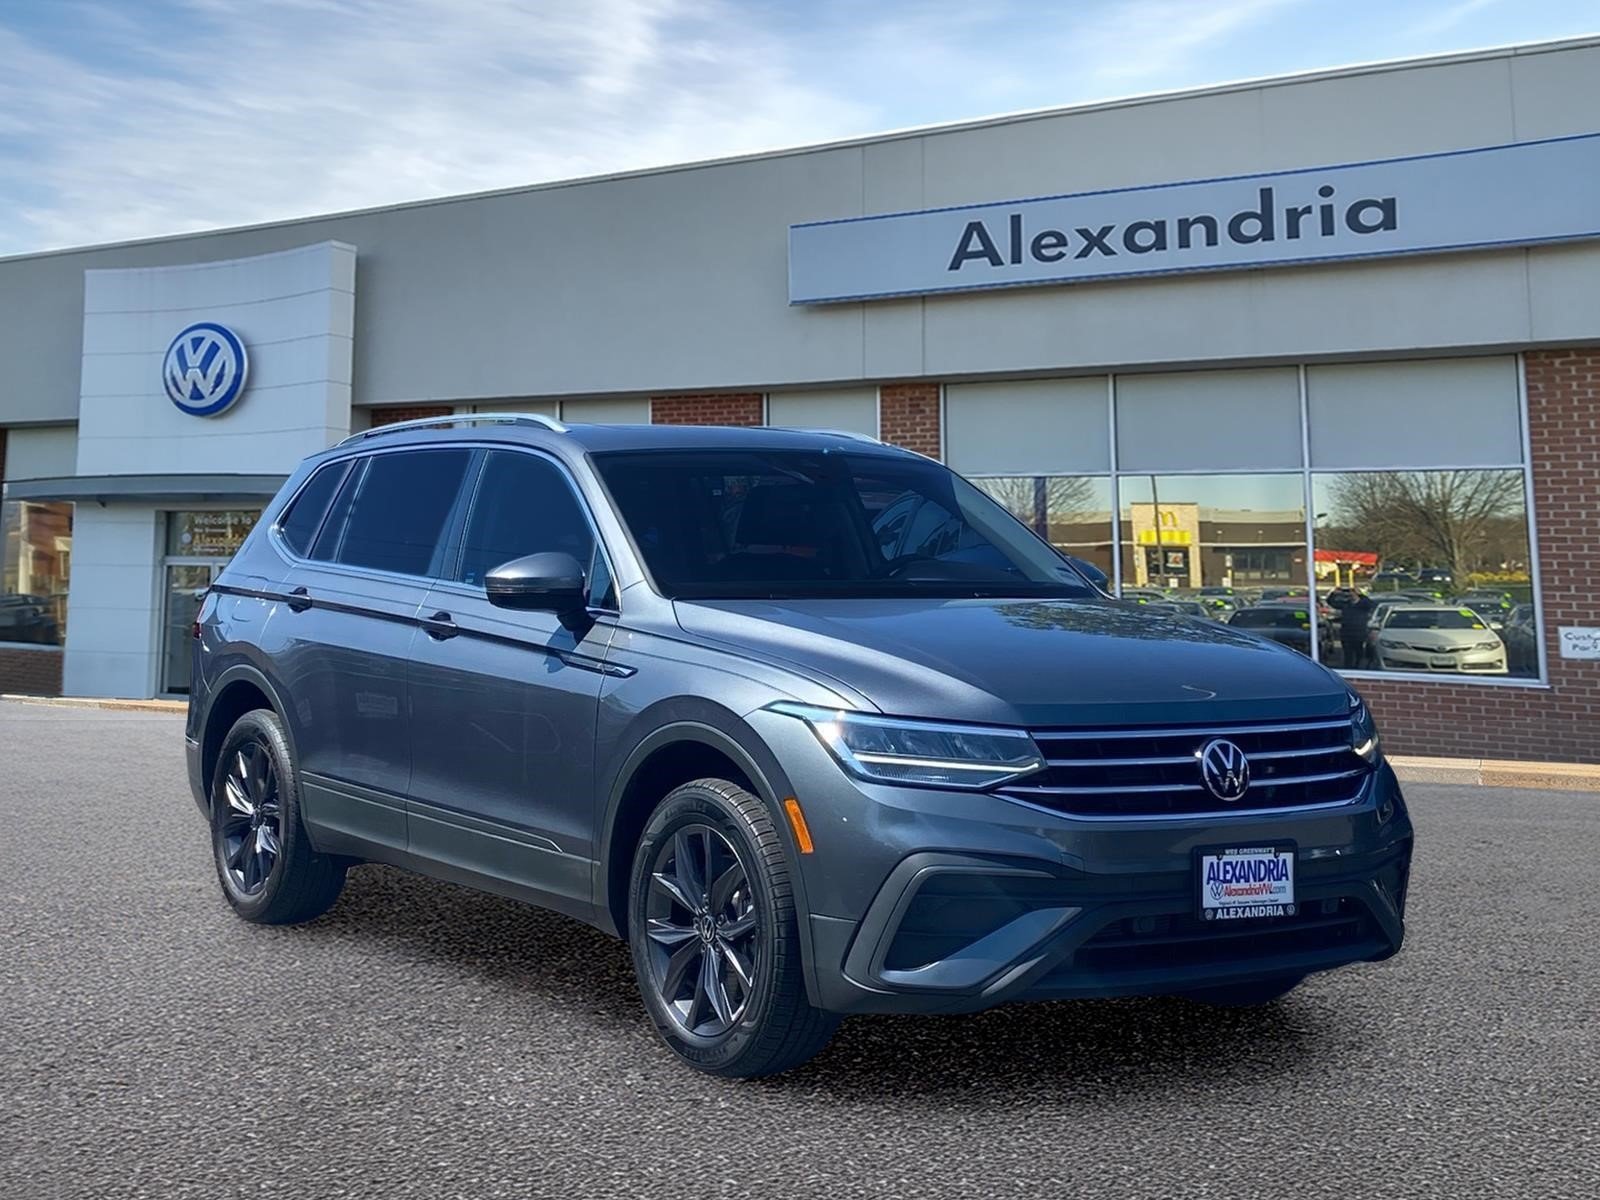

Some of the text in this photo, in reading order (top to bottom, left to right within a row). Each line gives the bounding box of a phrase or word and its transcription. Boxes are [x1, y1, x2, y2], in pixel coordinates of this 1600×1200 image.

[947, 185, 1397, 271] Alexandria
[1207, 859, 1289, 885] ALEXANDRIA
[1216, 906, 1284, 919] ALEXANDRIA
